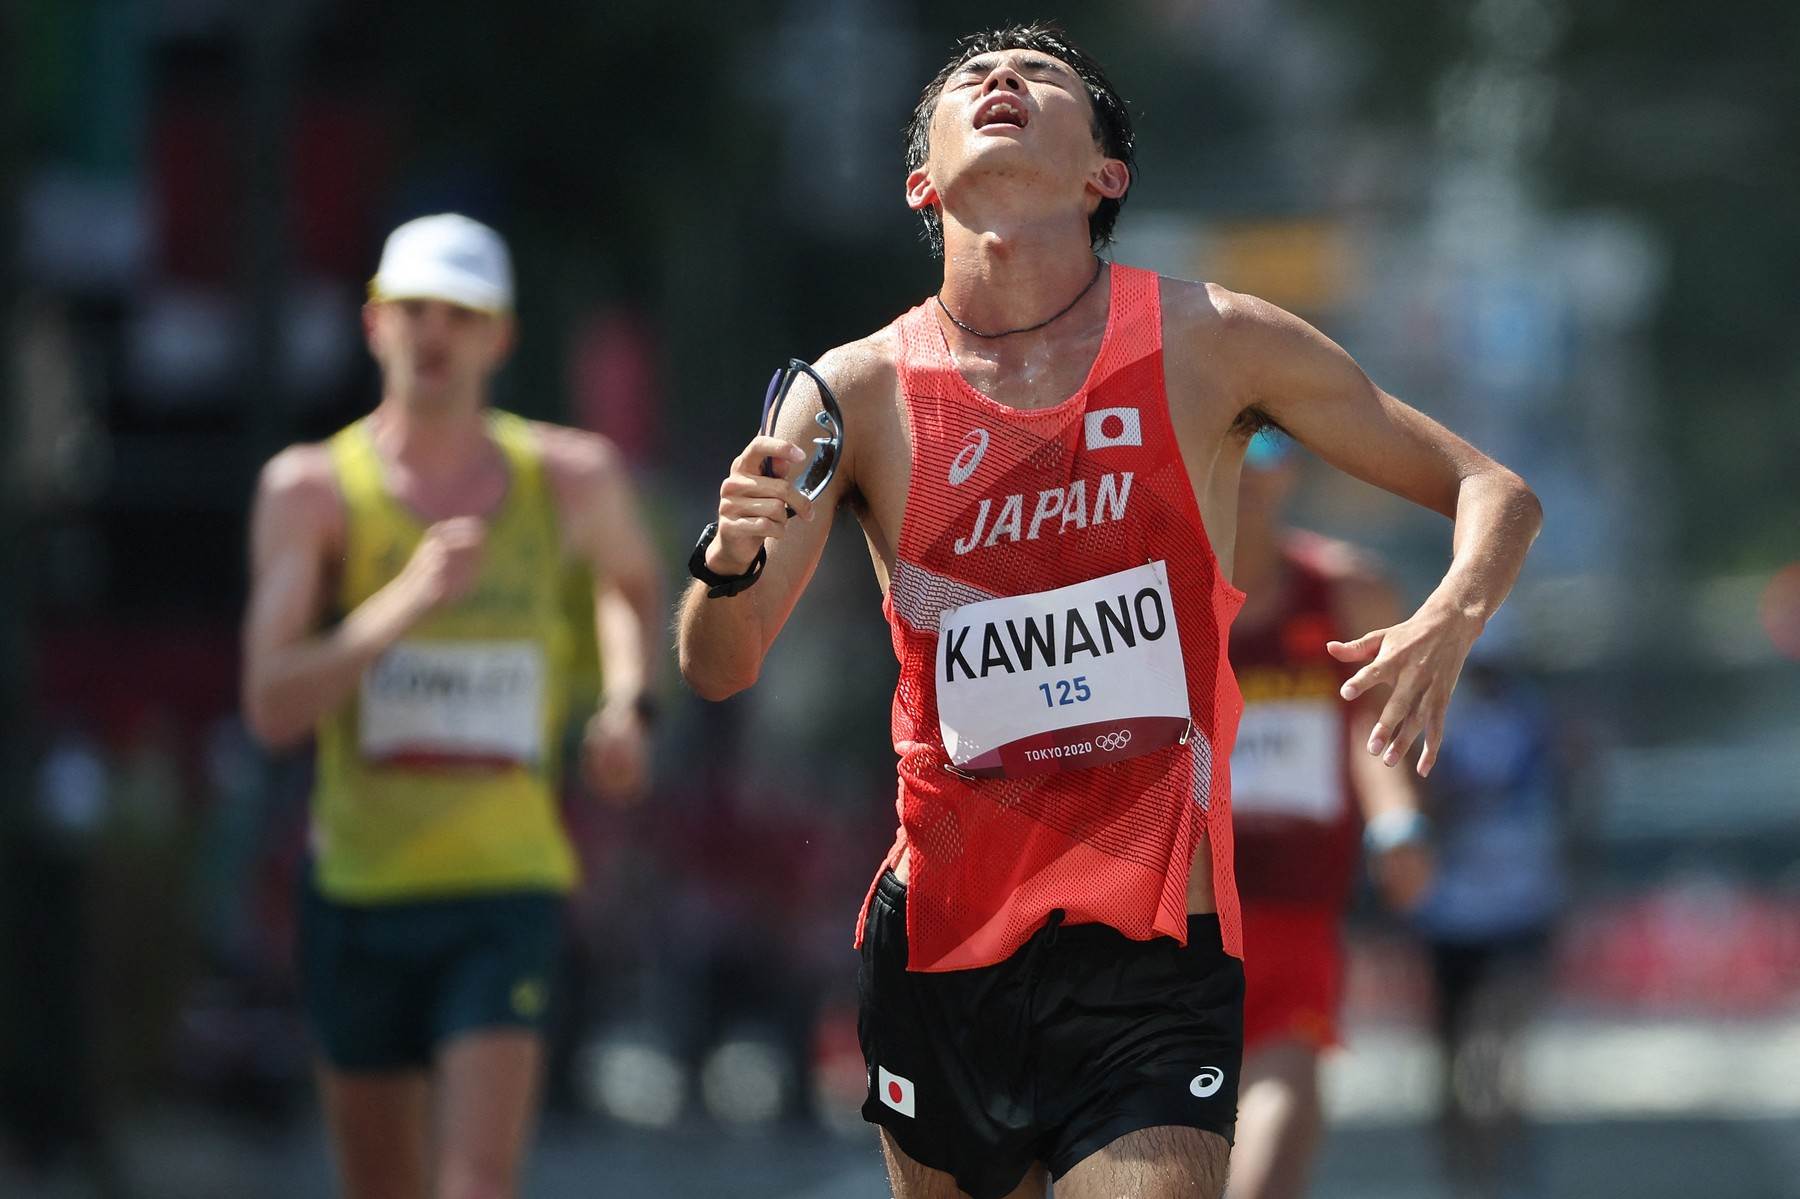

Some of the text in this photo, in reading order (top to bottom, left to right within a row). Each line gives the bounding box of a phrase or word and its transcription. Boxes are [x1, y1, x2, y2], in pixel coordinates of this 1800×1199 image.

[954, 472, 1134, 555] JAPAN
[945, 587, 1166, 682] KAWANO
[1038, 676, 1091, 708] 125
[1025, 742, 1092, 762] TOKYO 2020
